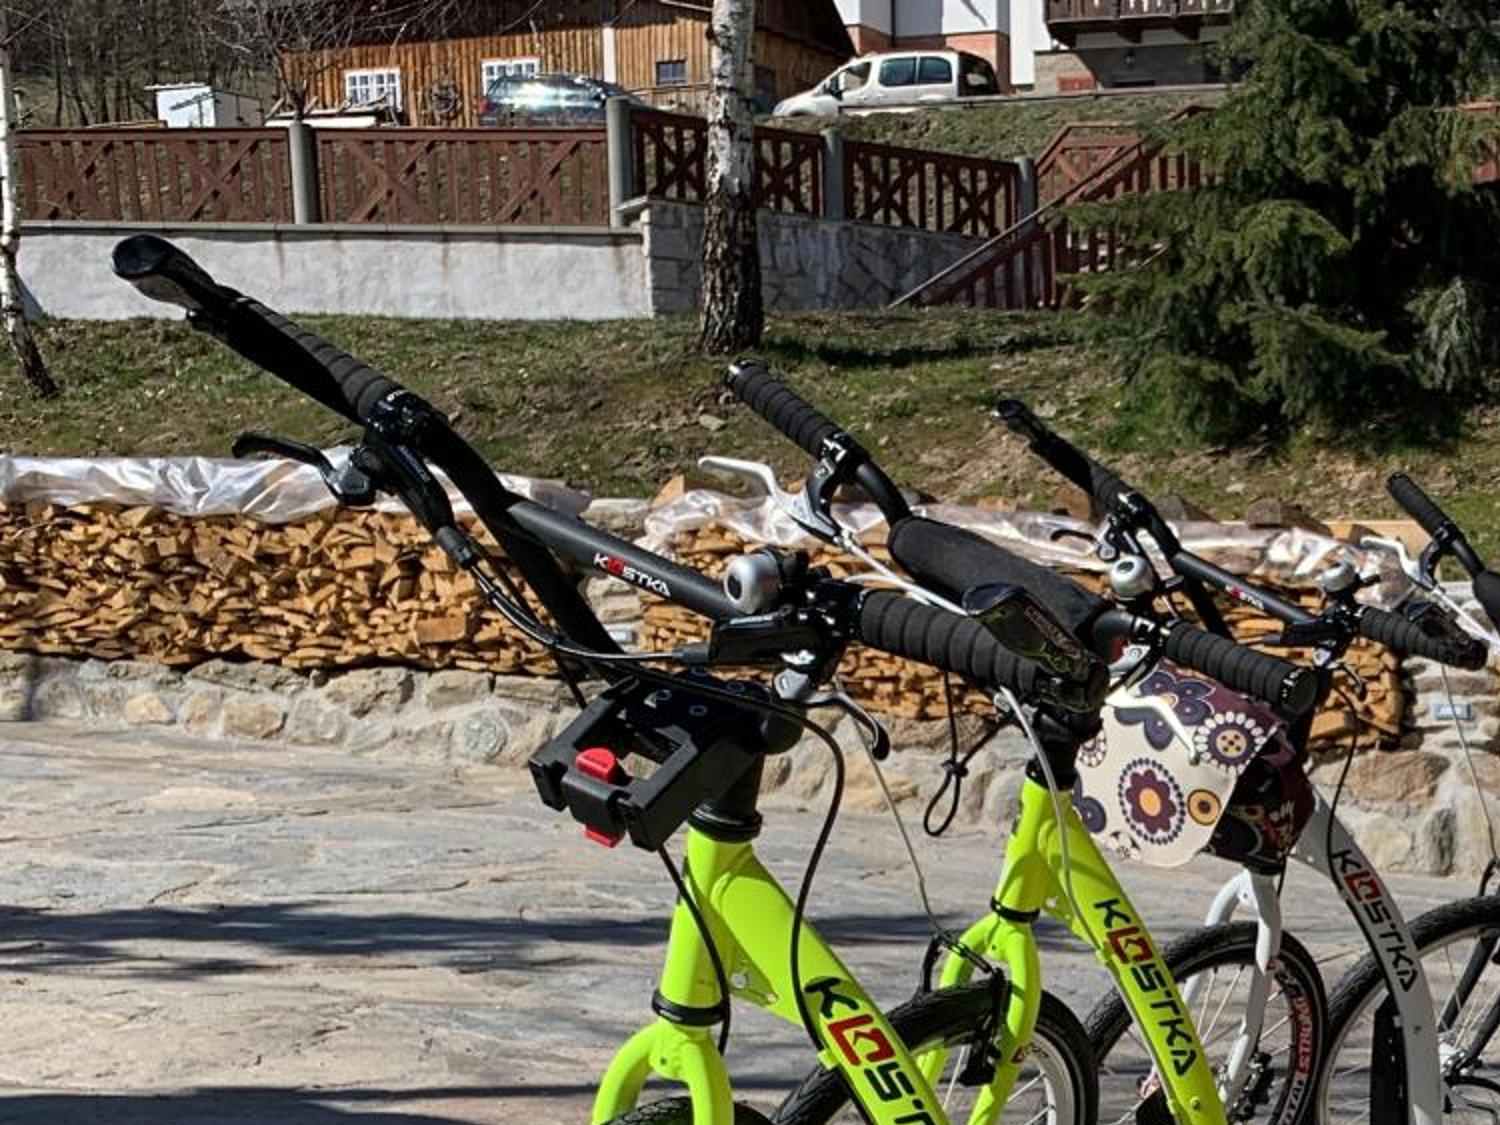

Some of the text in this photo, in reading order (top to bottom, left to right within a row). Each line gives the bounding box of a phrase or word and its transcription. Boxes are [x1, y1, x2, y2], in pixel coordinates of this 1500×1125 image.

[593, 552, 671, 598] KOSTKA
[1094, 897, 1197, 1077] KOSTKA
[1331, 848, 1417, 993] KOSTKA
